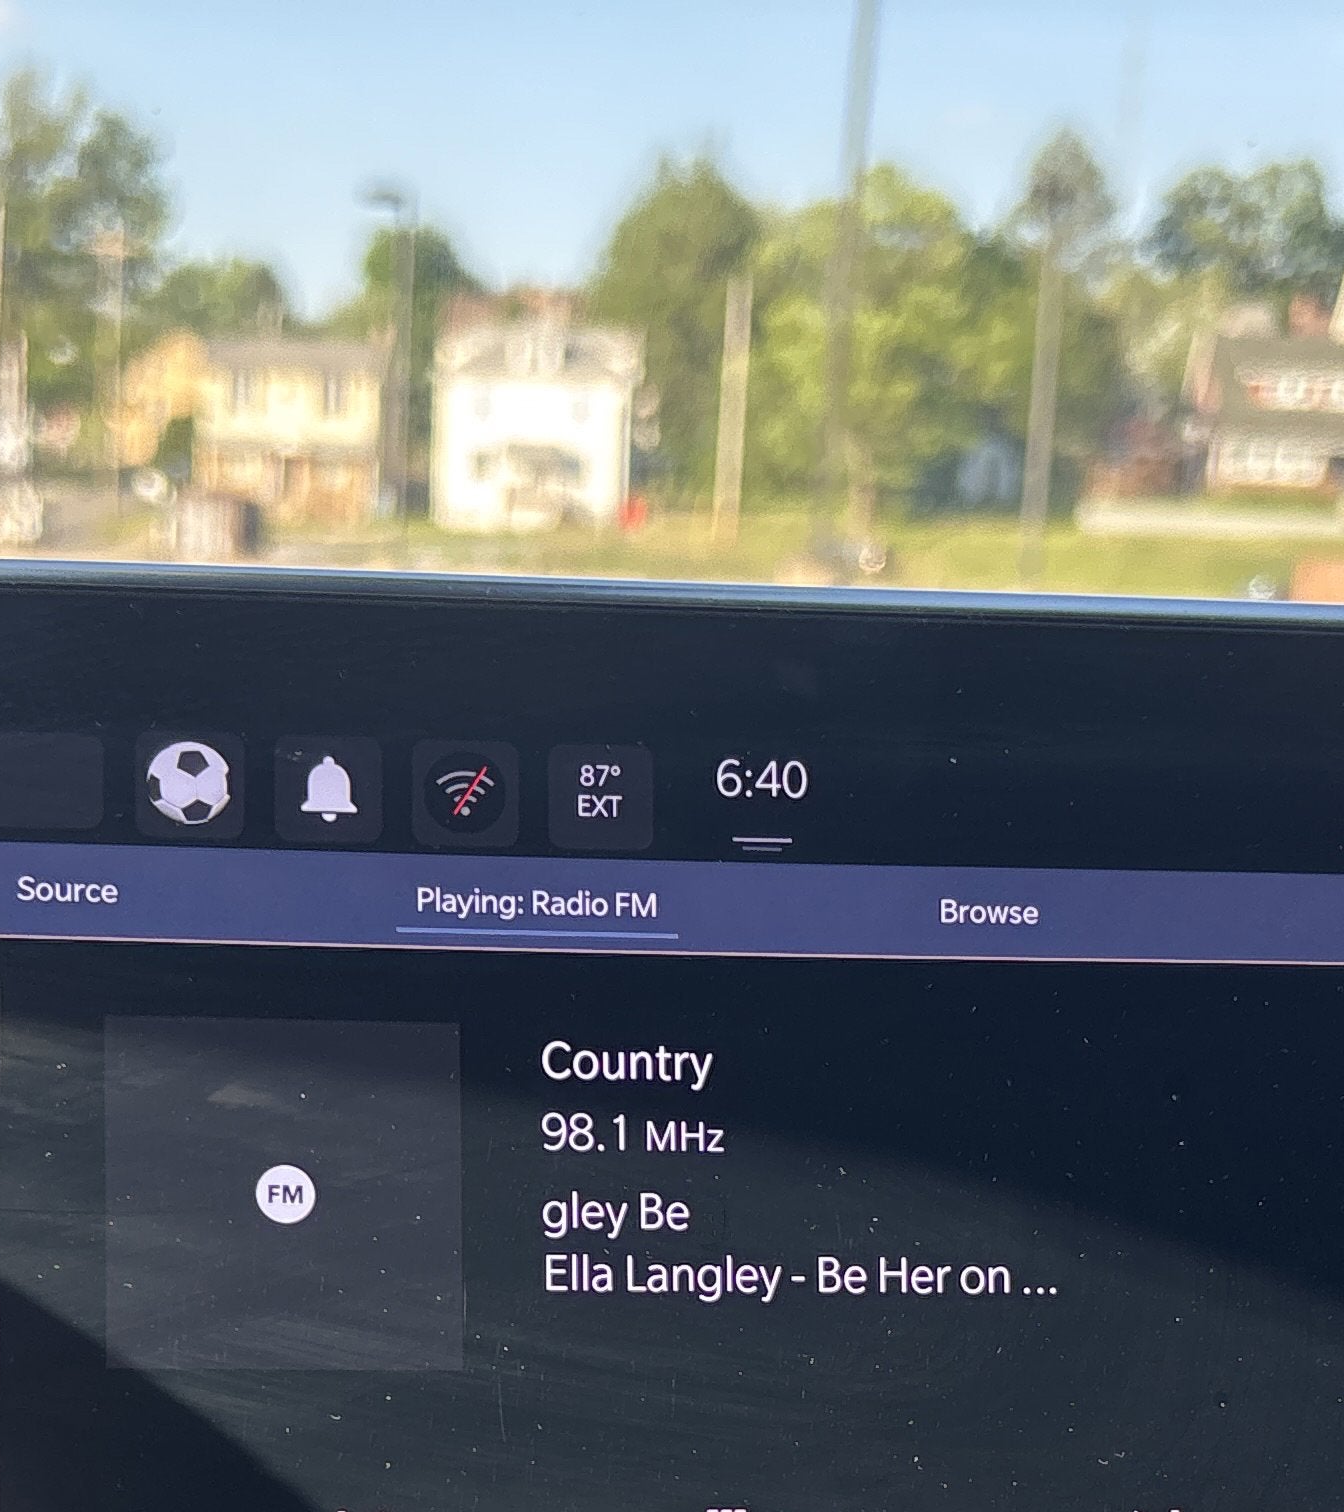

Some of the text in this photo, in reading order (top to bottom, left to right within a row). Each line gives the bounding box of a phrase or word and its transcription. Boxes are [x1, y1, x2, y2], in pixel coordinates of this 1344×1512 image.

[579, 764, 621, 787] 87°
[716, 758, 808, 799] 6:40
[577, 794, 623, 818] EXT
[16, 875, 119, 904] Source
[417, 886, 657, 920] Playing: Radio FM
[940, 898, 1039, 925] Browse
[541, 1040, 713, 1091] Country
[541, 1111, 725, 1153] 98.1 MHz
[266, 1184, 305, 1205] FM
[542, 1190, 690, 1239] gley Be
[545, 1253, 614, 1293] Ella
[626, 1254, 782, 1303] Langley
[817, 1256, 868, 1295] Be
[879, 1256, 952, 1295] Her
[959, 1265, 1011, 1295] on
